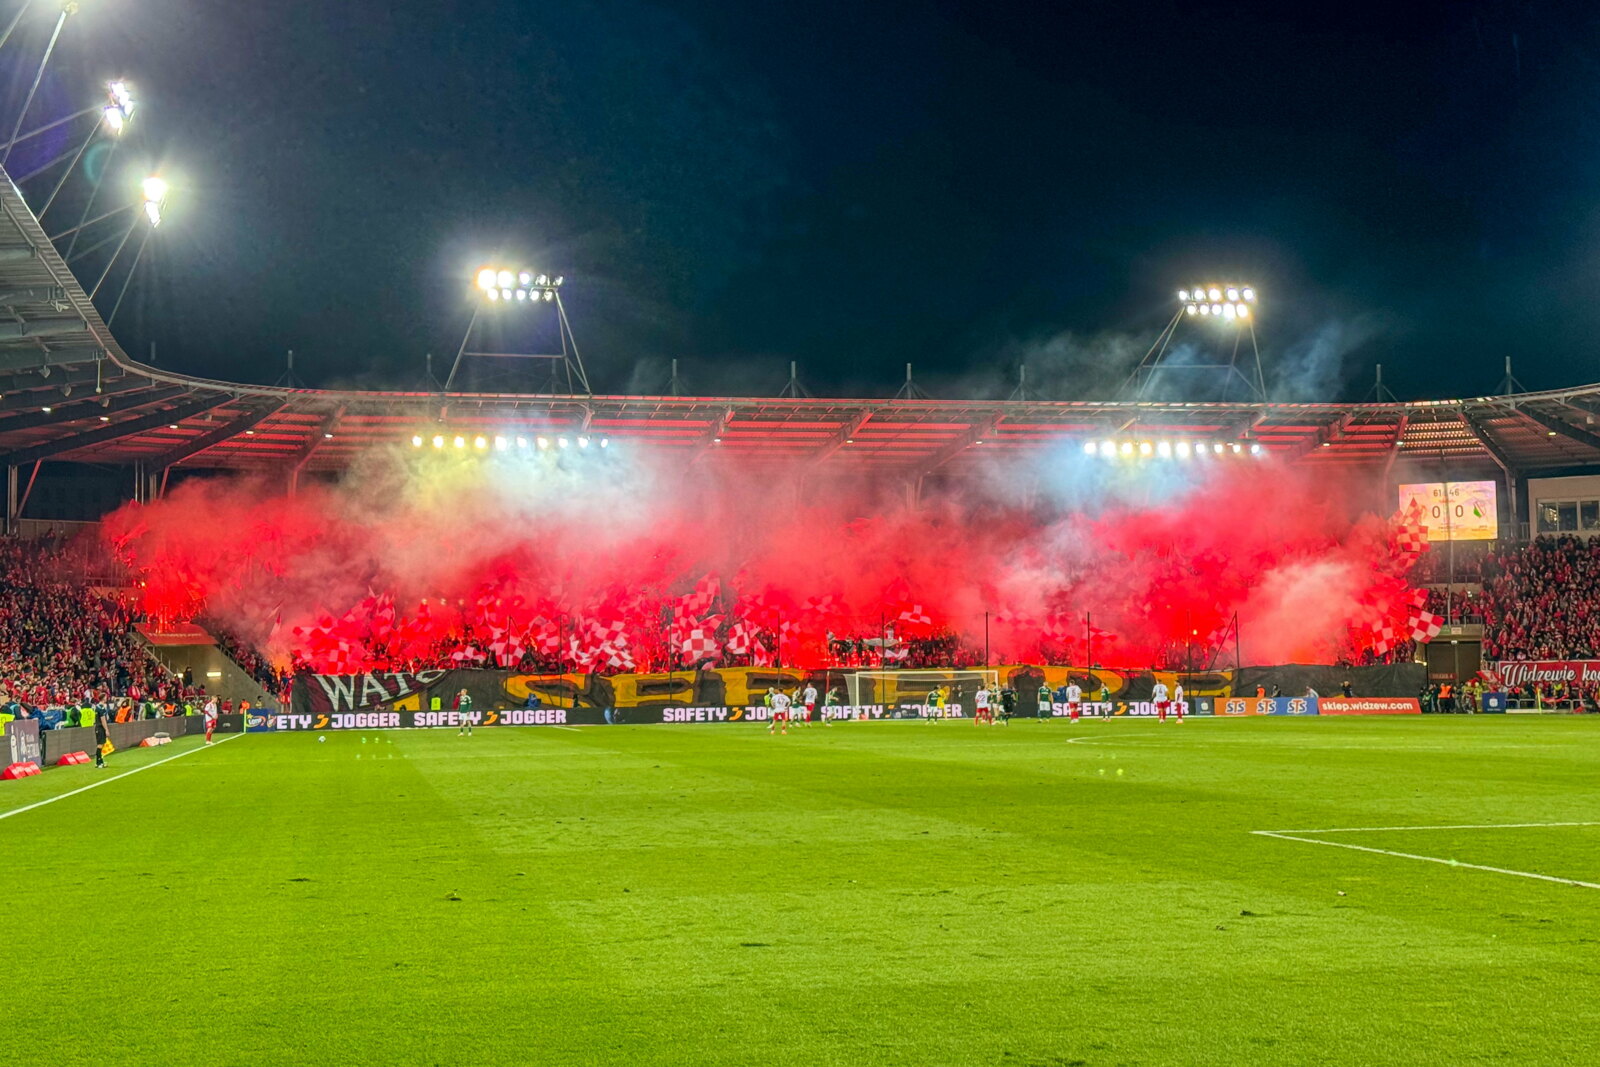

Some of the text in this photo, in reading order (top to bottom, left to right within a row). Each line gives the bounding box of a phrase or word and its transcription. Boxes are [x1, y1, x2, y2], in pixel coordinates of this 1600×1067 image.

[1432, 504, 1464, 518] 0 0
[1582, 663, 1600, 681] ko
[1129, 701, 1189, 715] JOGER
[1225, 698, 1246, 714] STS
[1257, 698, 1277, 714] STS
[1287, 698, 1308, 713] STS
[1322, 700, 1413, 712] sklep.widzew.com
[276, 714, 312, 729] ETY
[331, 712, 400, 728] JOGGER
[413, 710, 566, 726] SAFEY JOGGER
[663, 707, 728, 722] SAFETY
